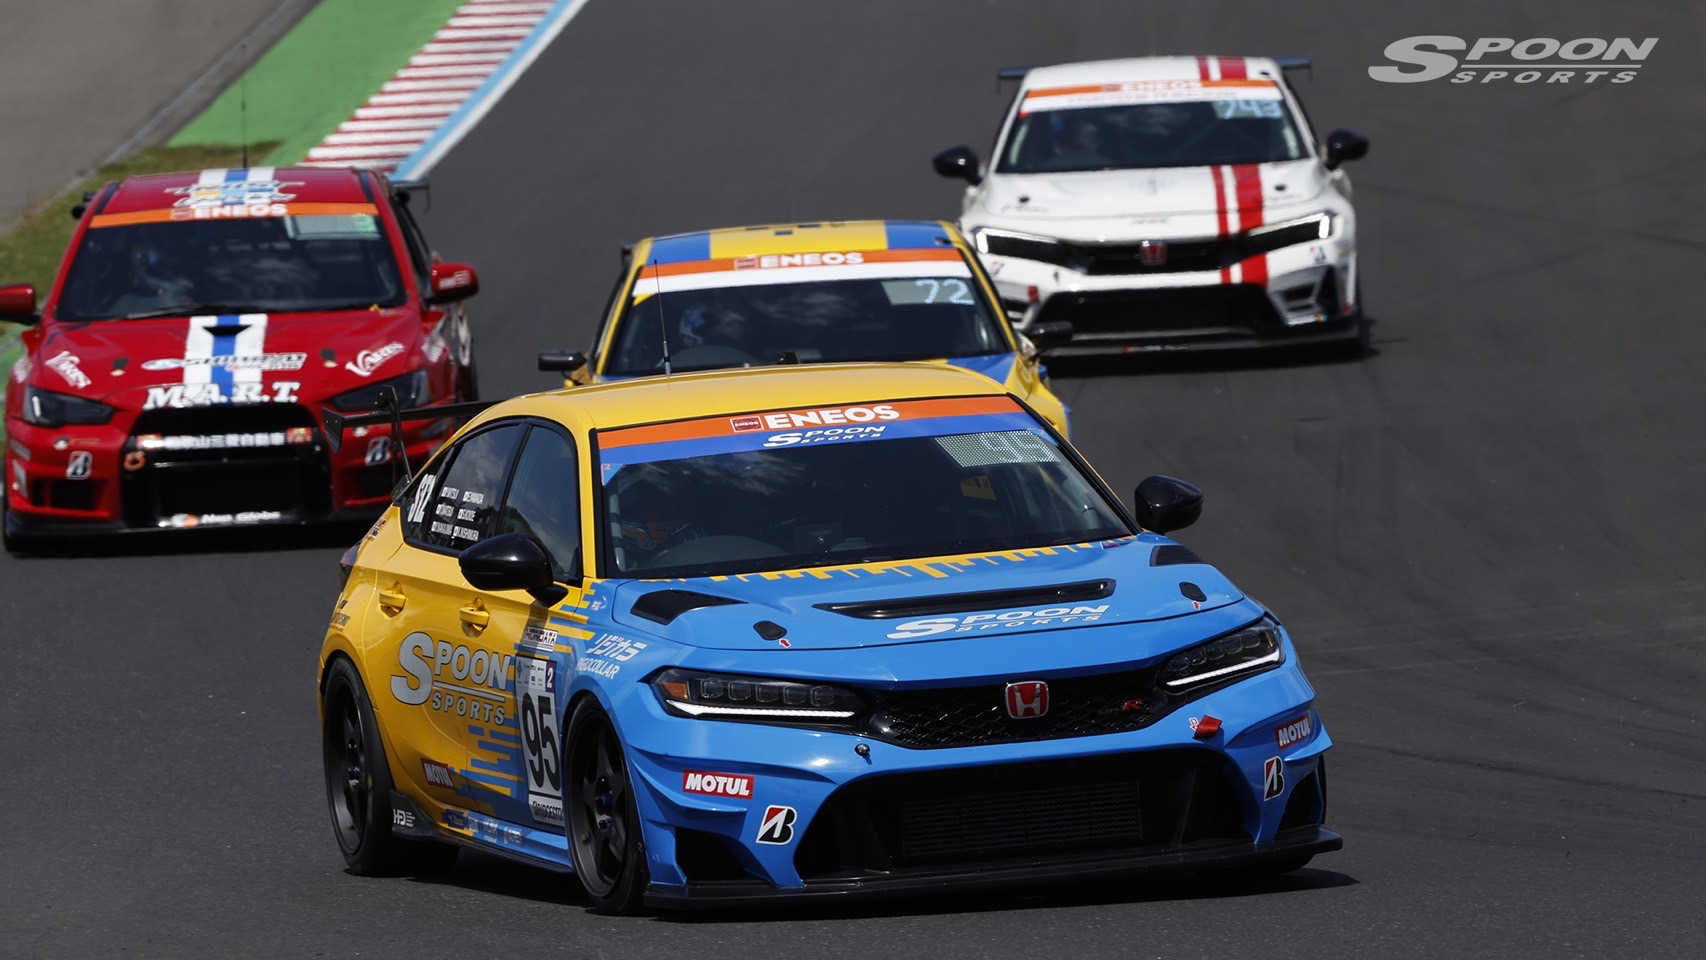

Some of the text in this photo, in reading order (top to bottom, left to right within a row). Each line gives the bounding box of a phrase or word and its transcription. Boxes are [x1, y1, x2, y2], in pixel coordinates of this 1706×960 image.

[1121, 80, 1203, 92] ENEOS
[194, 203, 288, 219] ENEOS
[760, 252, 864, 268] ENEOS
[916, 278, 974, 304] 72
[764, 405, 900, 429] ENEOS
[763, 426, 886, 448] SPOON
[800, 433, 881, 444] SPORTS
[886, 604, 1110, 640] SPOON
[954, 615, 1102, 633] SPORTS
[390, 631, 511, 706] SPOON
[546, 667, 554, 689] 2
[432, 690, 505, 726] SPORTS
[522, 692, 561, 792] 95
[1278, 717, 1312, 747] MOTUL
[423, 762, 454, 787] MOTUL
[685, 773, 750, 796] MOTUL
